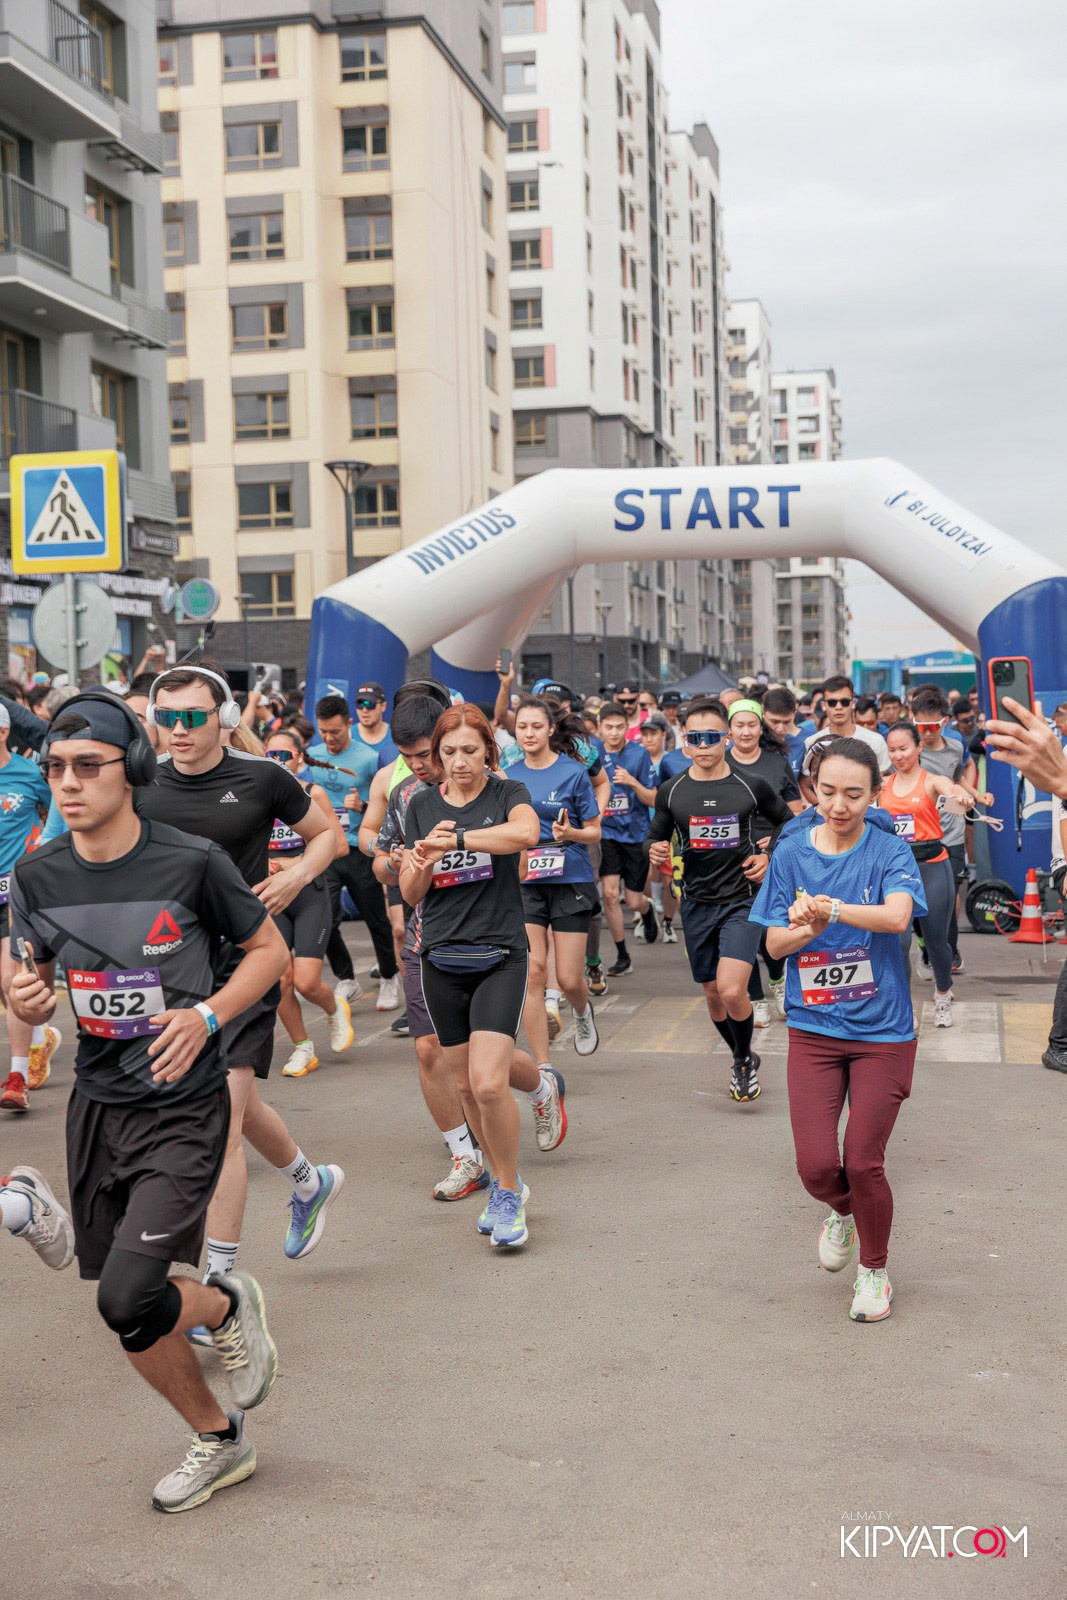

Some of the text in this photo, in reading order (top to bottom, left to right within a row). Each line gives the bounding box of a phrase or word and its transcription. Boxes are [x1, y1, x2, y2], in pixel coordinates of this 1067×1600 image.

[614, 485, 801, 531] START
[906, 500, 929, 515] BI
[406, 507, 517, 575] INVICTUS
[271, 828, 294, 840] 484
[700, 826, 730, 838] 255
[894, 823, 908, 833] 07
[441, 852, 477, 871] 525
[529, 857, 555, 870] 031
[142, 939, 182, 956] Reebok
[73, 973, 96, 984] 10 KM
[125, 974, 145, 982] GROUP
[813, 964, 858, 987] 497
[89, 991, 146, 1017] 052
